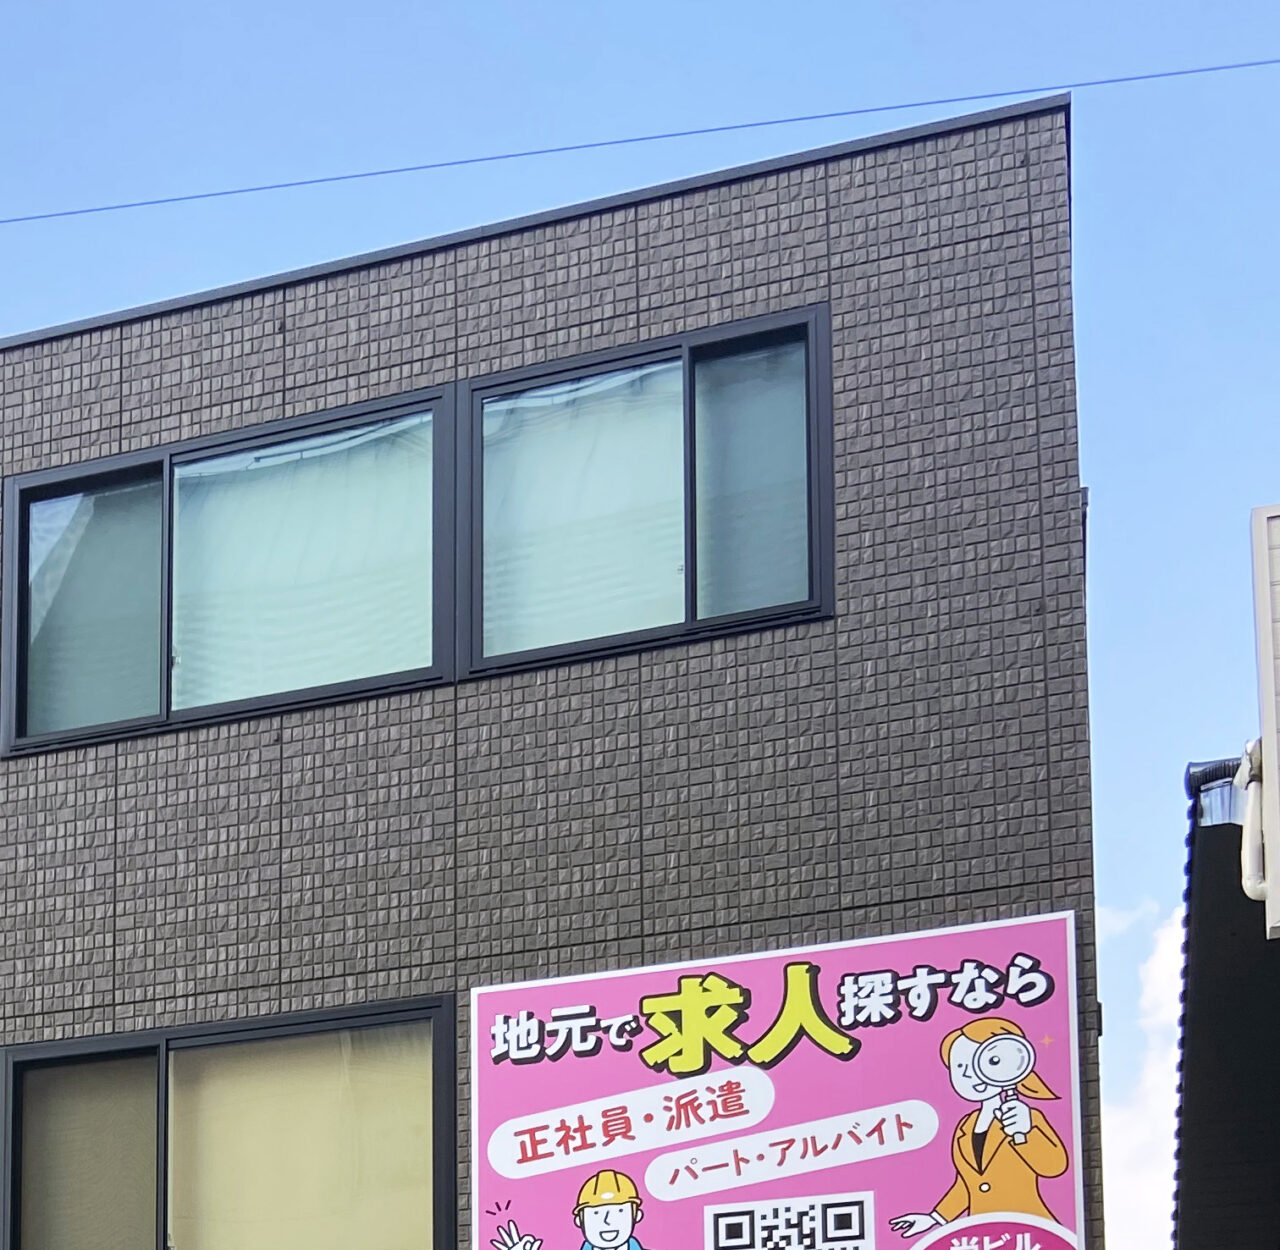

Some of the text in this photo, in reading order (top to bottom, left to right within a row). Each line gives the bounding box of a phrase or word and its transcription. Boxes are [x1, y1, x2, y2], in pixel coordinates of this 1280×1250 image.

[489, 953, 1053, 1076] 地元で求人探すなら
[516, 1080, 751, 1165] 正社員・派遣
[668, 1114, 914, 1185] パート・アルバイト
